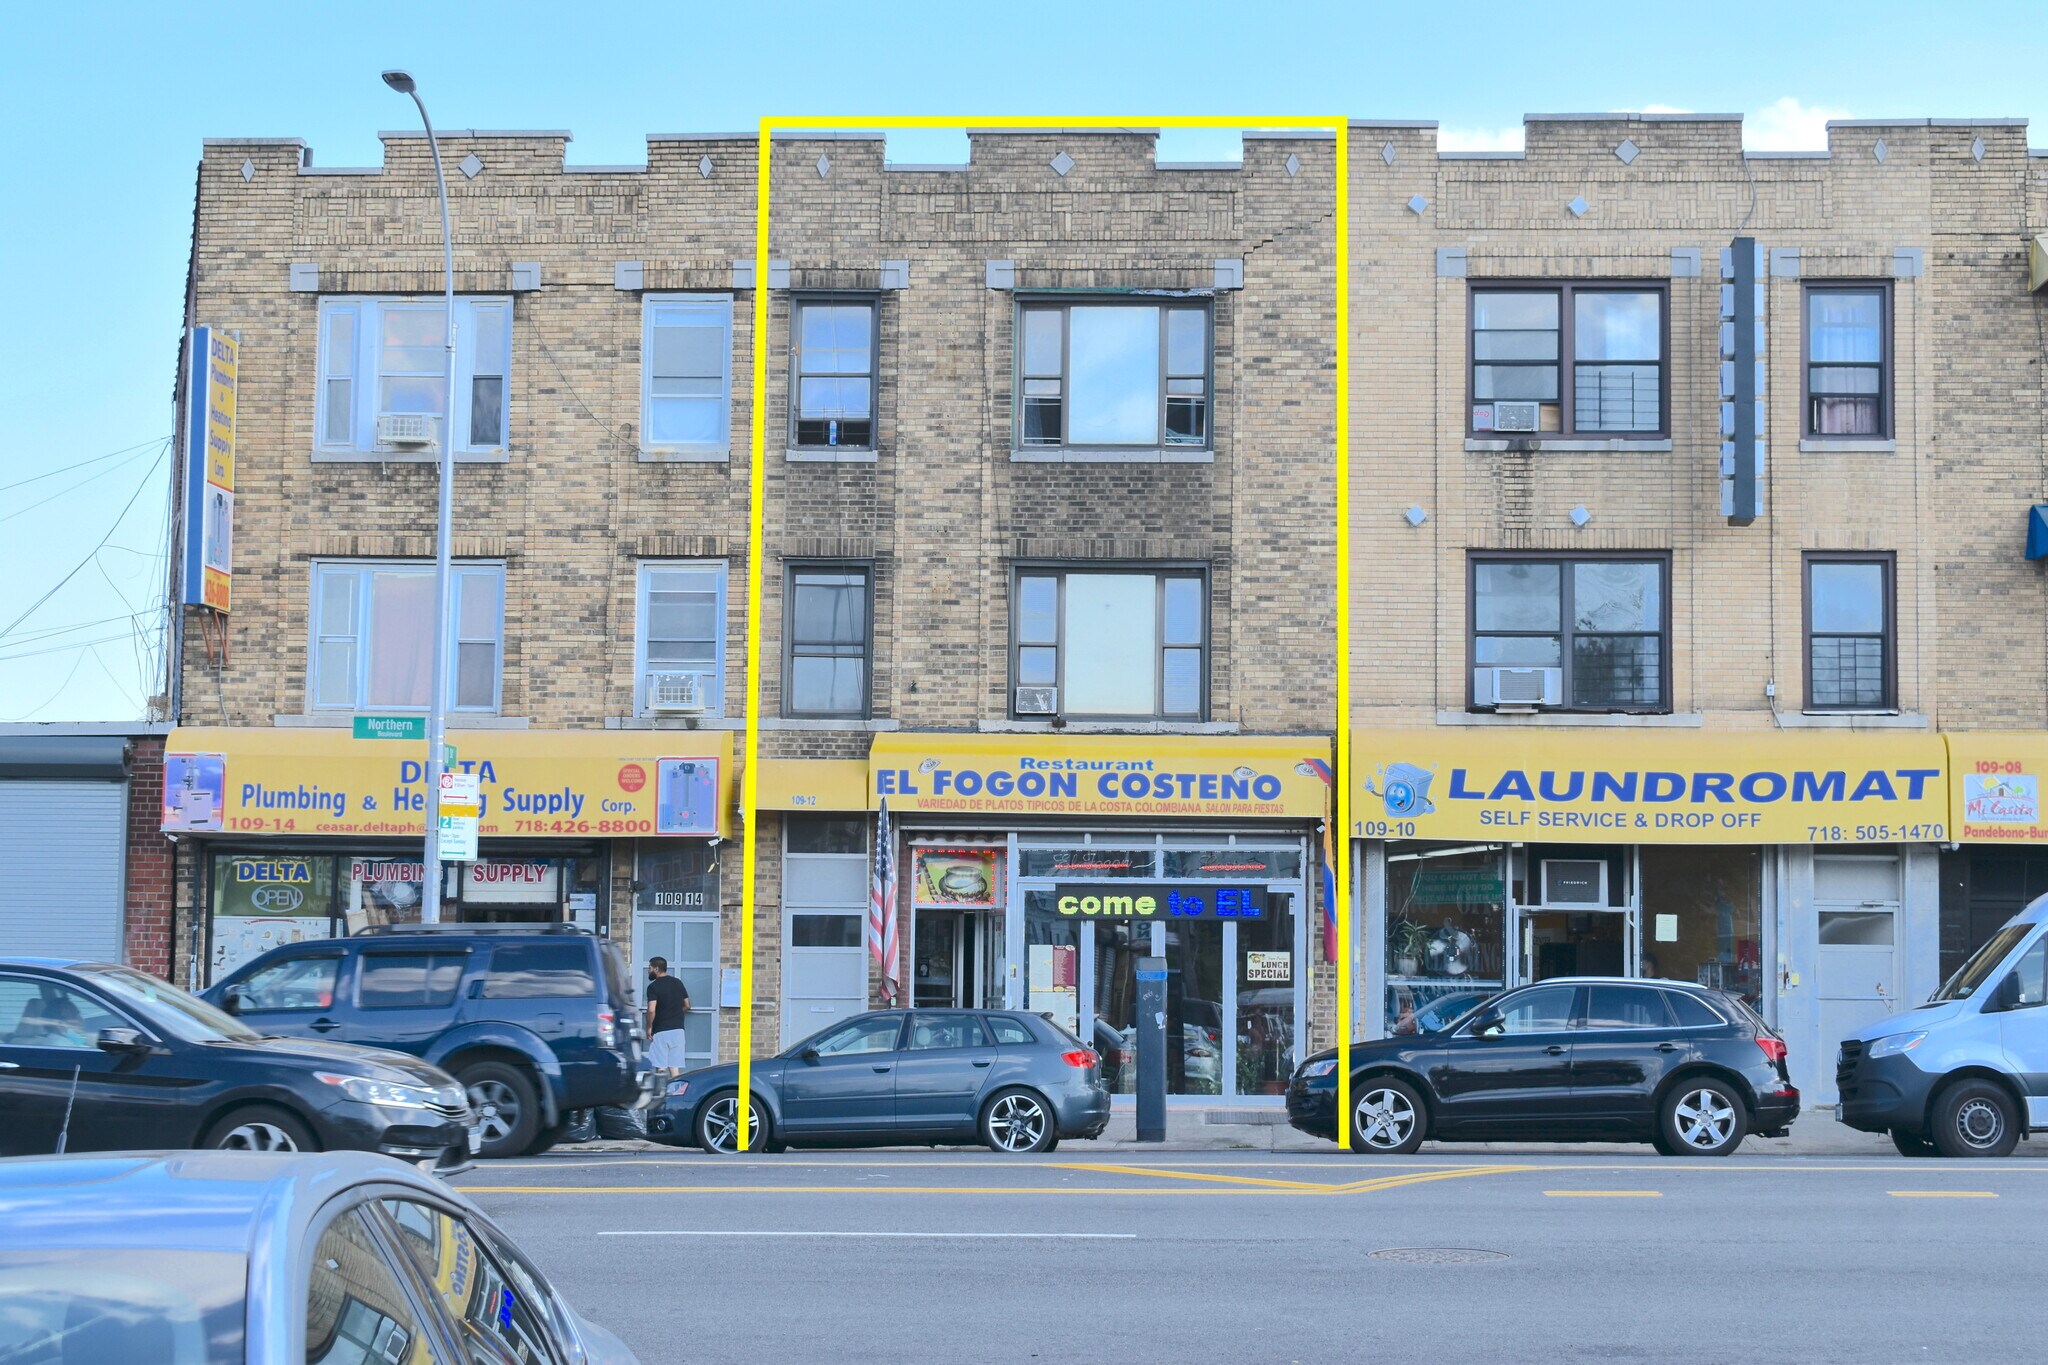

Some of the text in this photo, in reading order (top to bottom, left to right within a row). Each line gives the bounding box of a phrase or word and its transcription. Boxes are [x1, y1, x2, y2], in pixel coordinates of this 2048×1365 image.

[212, 338, 234, 366] DELTA
[210, 429, 231, 459] Supply
[368, 718, 413, 730] Northern
[401, 760, 497, 784] DTA
[1020, 757, 1154, 771] Restaurant
[1976, 761, 2022, 774] 109-08
[876, 769, 918, 795] EL
[933, 770, 1077, 798] FOGON
[1448, 768, 1940, 803] LAUNDROMAT
[241, 783, 346, 817] Plumbing
[362, 795, 377, 810] &
[502, 787, 585, 819] Supply
[601, 798, 636, 815] Corp.
[791, 795, 816, 806] 109-12
[917, 798, 1284, 814] VARIEDAD DE PLATOS TIPICOS DE LA COSTA COLOMBIANA SALON PARA FIESTAS
[1968, 800, 2033, 817] Mi Casita
[229, 817, 295, 831] 109-14
[443, 816, 449, 828] 2
[1480, 810, 1761, 828] SELF SERVICE & DROP OFF
[1354, 821, 1416, 837] 109-10
[1807, 824, 1944, 841] 718: 505-1470
[238, 862, 310, 883] DELTA
[352, 863, 547, 883] PLUMBIN SUPPLY
[255, 889, 299, 906] OPEN
[1058, 889, 1261, 917] come to EL
[1261, 961, 1289, 969] LUNCH
[1248, 969, 1289, 979] SPECIAL
